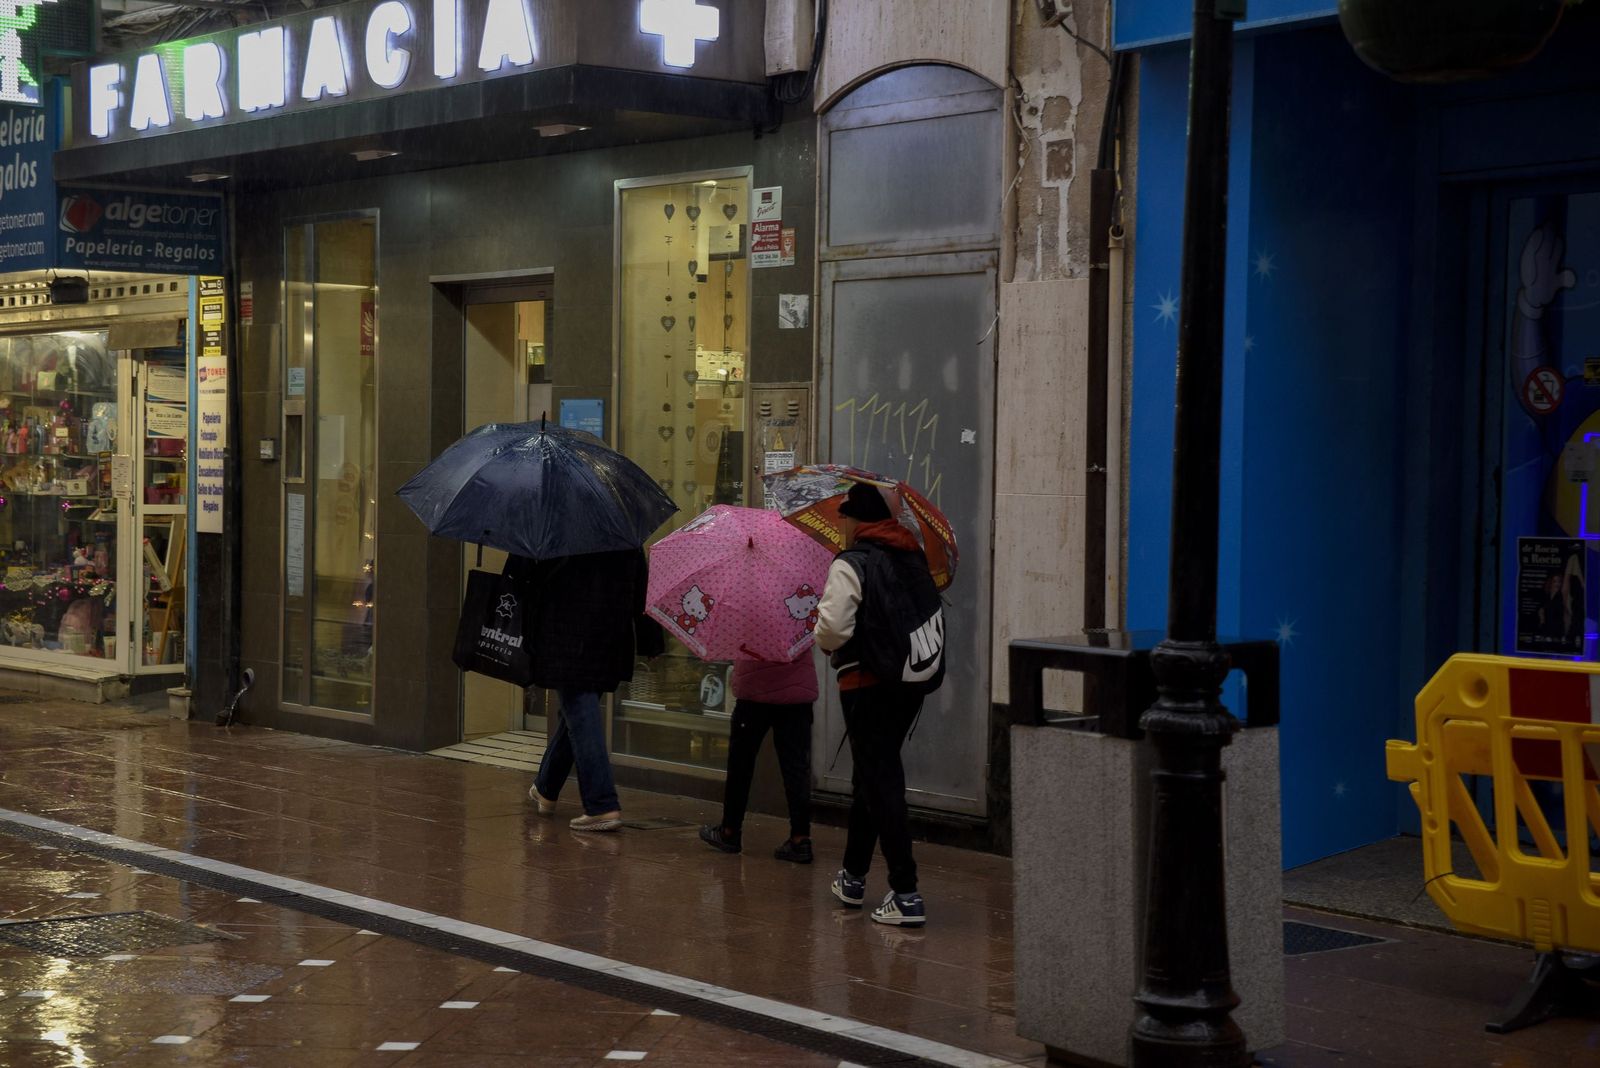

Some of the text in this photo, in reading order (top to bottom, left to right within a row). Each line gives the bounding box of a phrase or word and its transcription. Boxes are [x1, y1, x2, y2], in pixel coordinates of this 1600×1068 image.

[89, 0, 535, 138] FARMACIA
[105, 196, 219, 229] algetoner
[754, 223, 780, 233] Alarma
[66, 237, 144, 258] Papelería
[155, 242, 216, 263] Regalos
